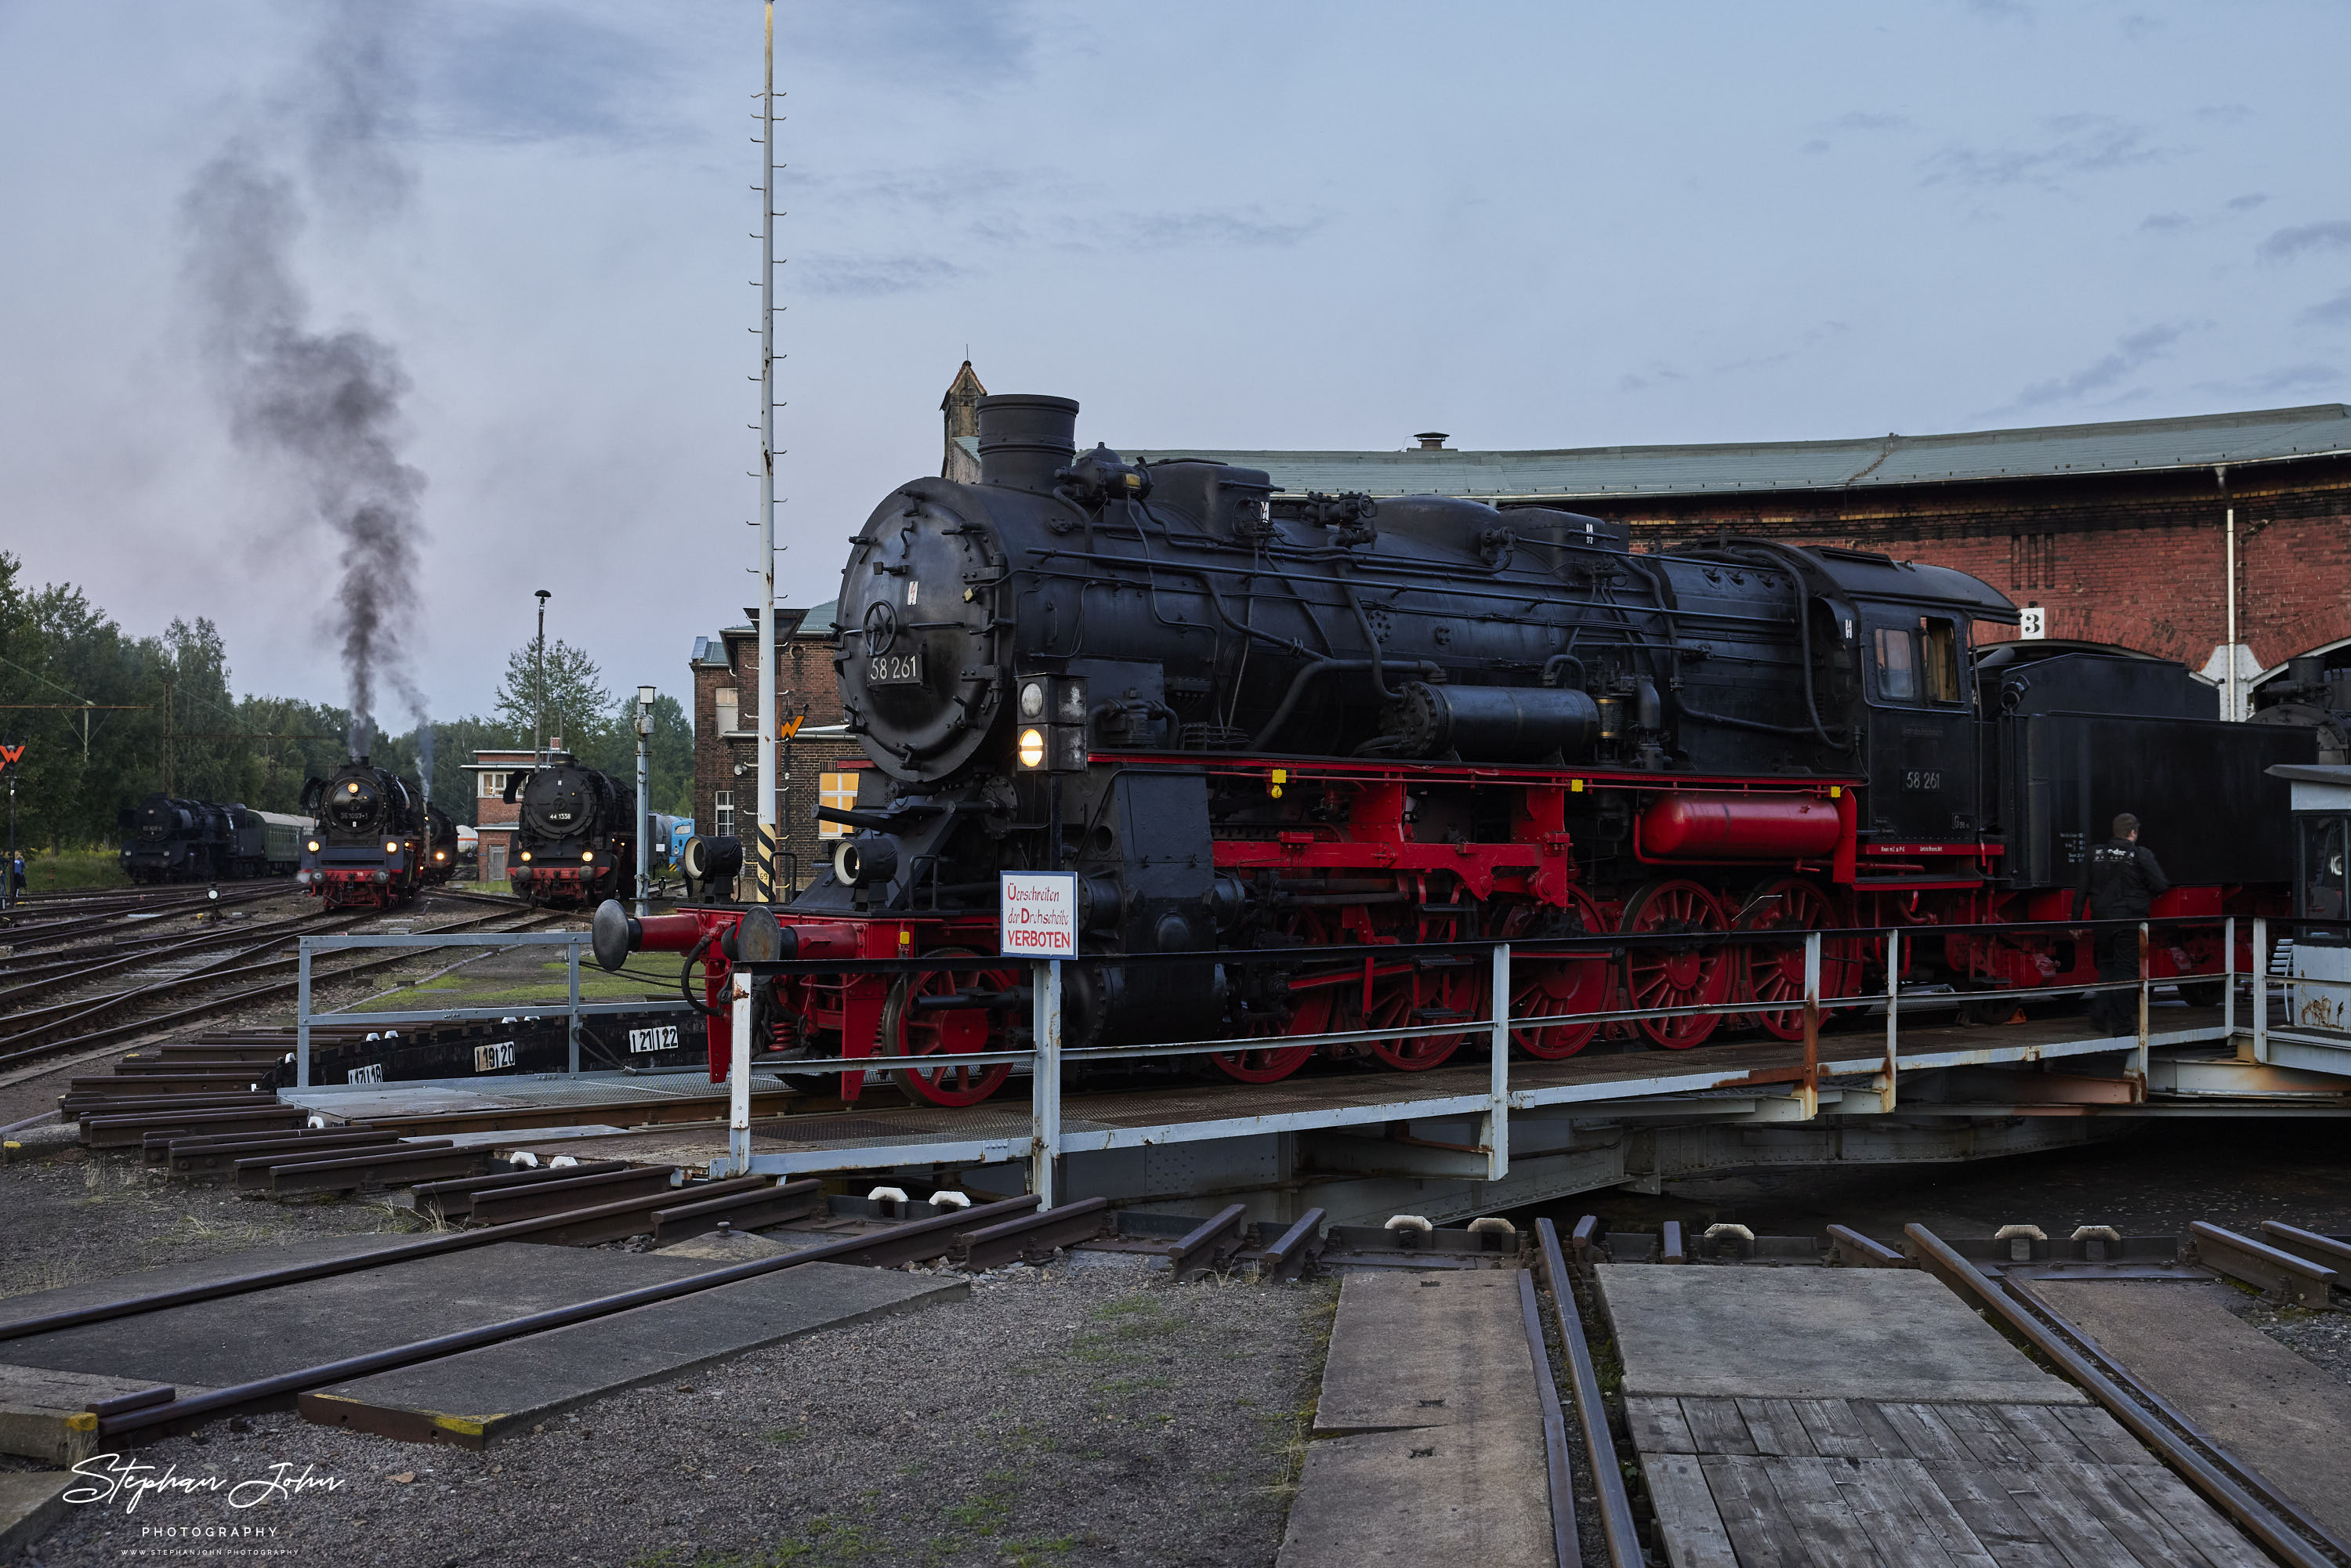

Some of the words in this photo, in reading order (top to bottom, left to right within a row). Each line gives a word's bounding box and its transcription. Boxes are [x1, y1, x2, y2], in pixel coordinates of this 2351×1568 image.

[2025, 614, 2041, 633] 3
[870, 657, 888, 680] 58
[891, 655, 916, 679] 261
[1906, 771, 1920, 788] 58
[1924, 772, 1940, 789] 261
[1008, 907, 1020, 924] der
[1008, 929, 1070, 948] VERBOTEN
[639, 1030, 652, 1050] 21
[662, 1027, 678, 1048] 22
[483, 1047, 495, 1068] 19
[501, 1044, 514, 1066] 20
